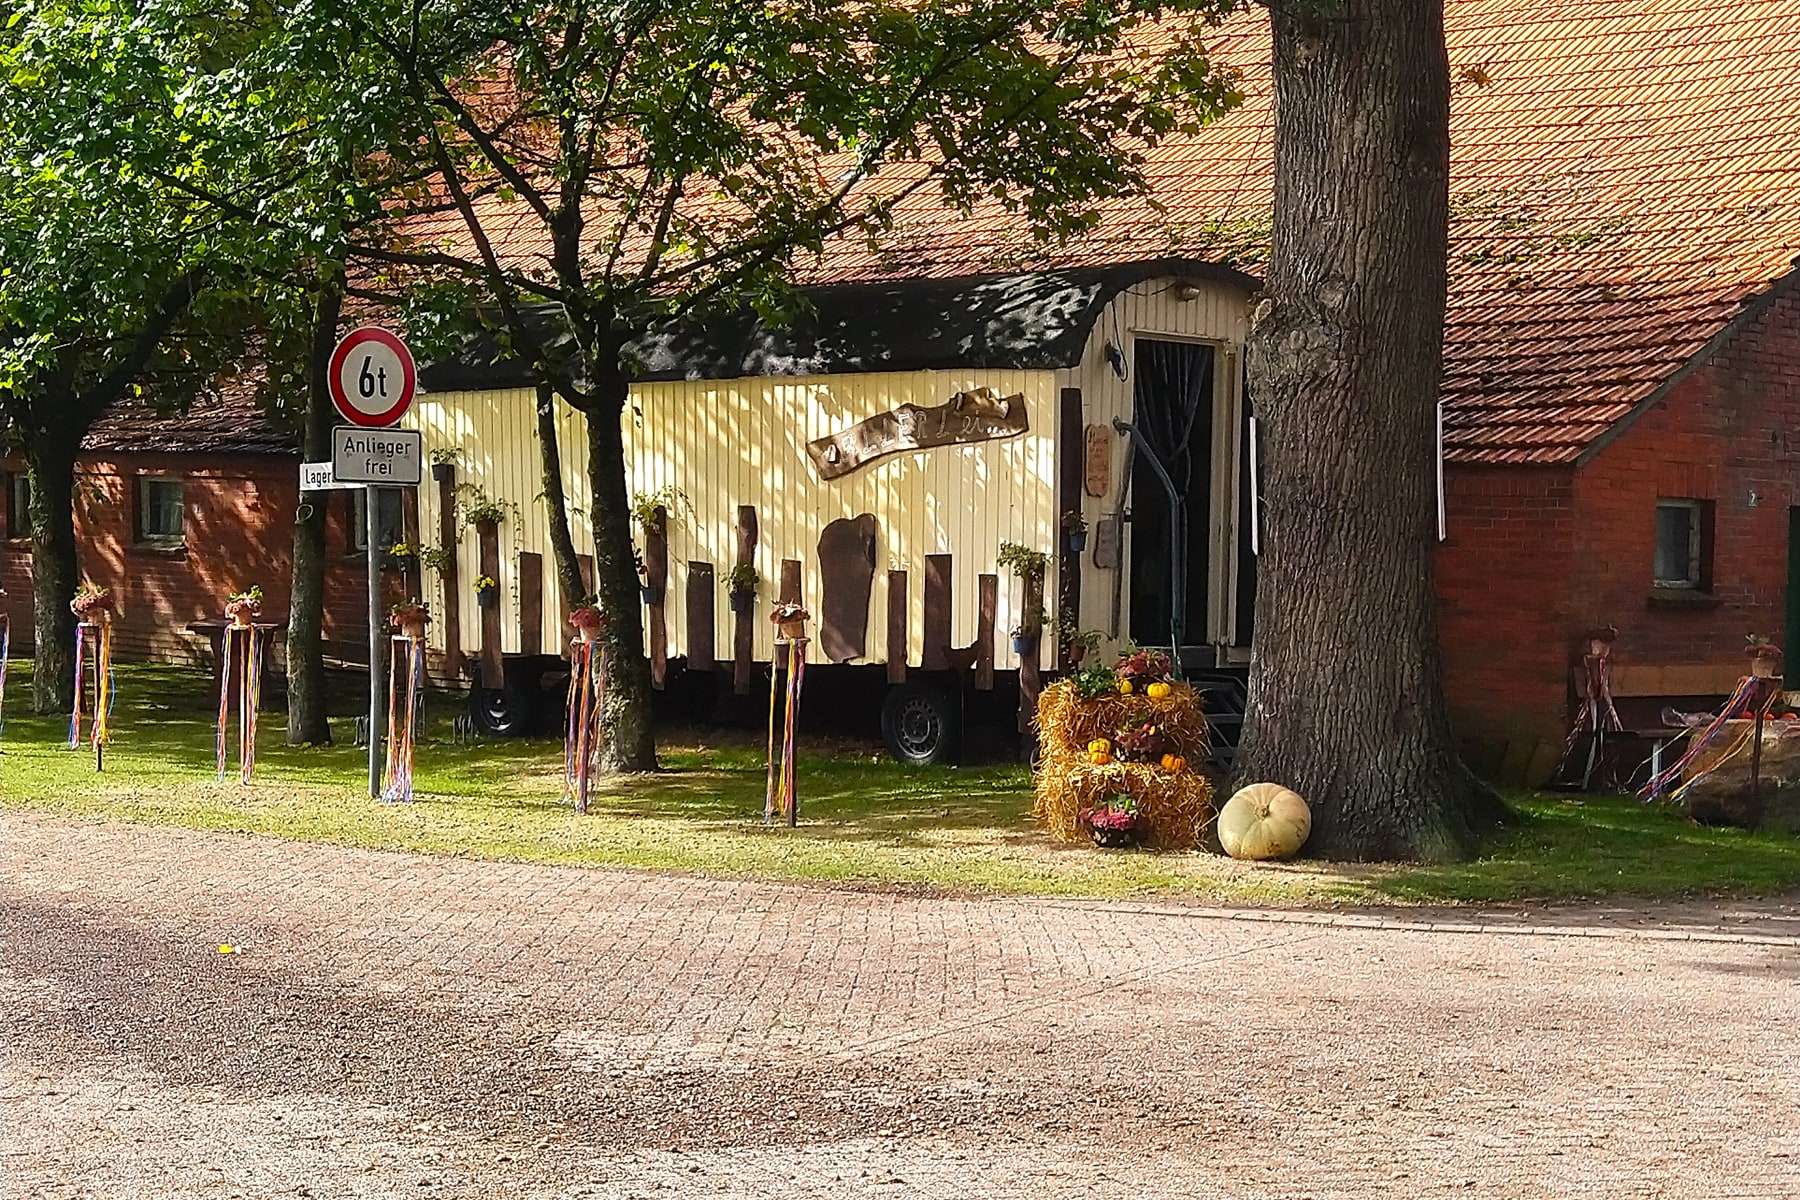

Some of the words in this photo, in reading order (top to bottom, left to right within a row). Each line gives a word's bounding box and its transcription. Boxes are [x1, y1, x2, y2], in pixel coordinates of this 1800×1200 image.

[344, 436, 412, 458] Anlieger
[365, 459, 392, 475] frei
[305, 468, 335, 487] Lager
